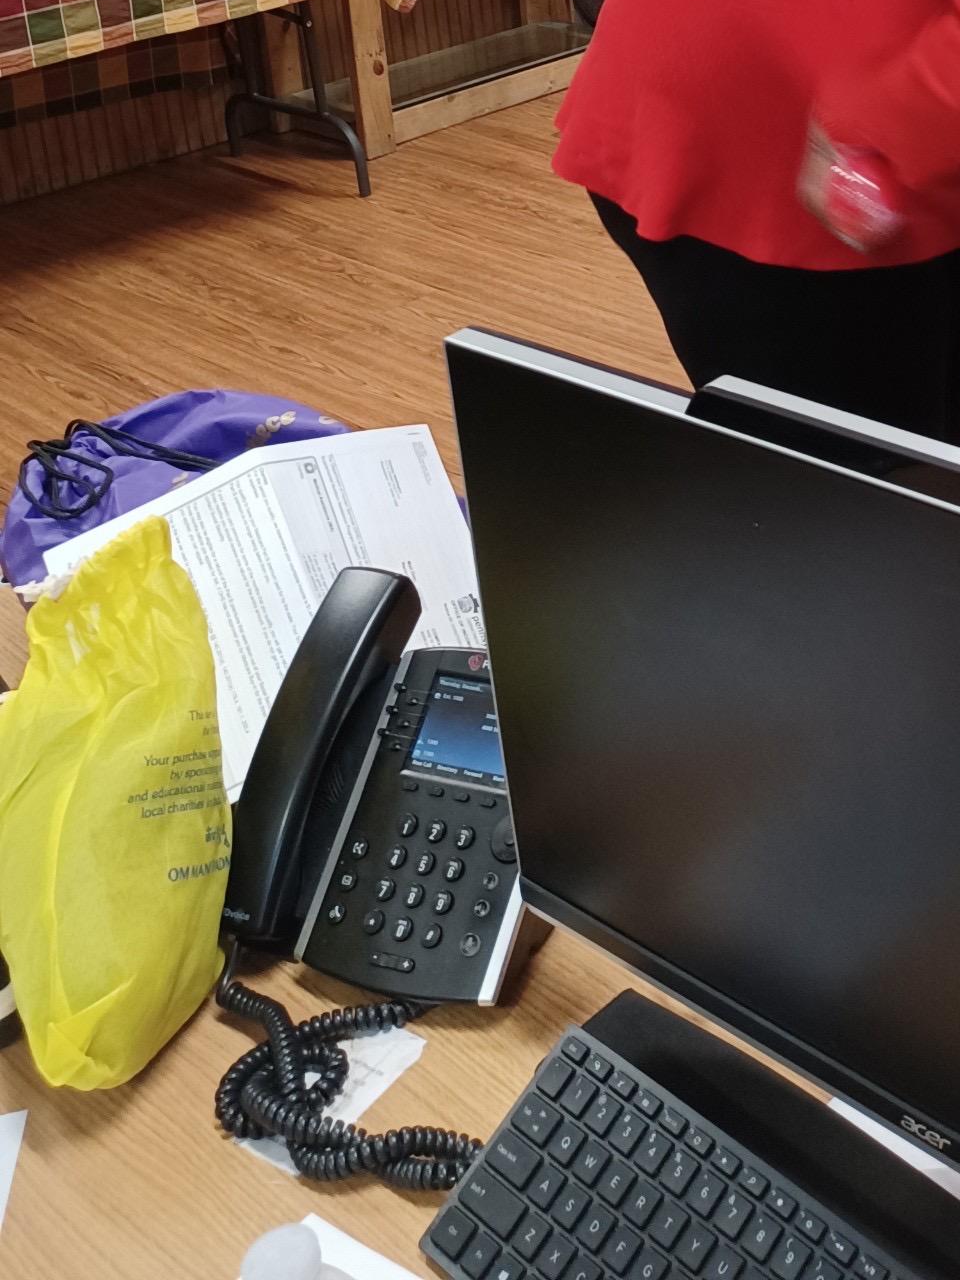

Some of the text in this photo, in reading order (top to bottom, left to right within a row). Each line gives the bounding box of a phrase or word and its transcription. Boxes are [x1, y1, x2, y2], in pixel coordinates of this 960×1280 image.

[144, 755, 170, 767] Your
[128, 789, 149, 804] and
[152, 782, 206, 800] educational
[141, 803, 166, 819] local
[402, 822, 409, 835] 1
[428, 828, 437, 841] 2
[457, 834, 466, 847] 3
[390, 854, 399, 866] 4
[418, 859, 428, 872] 5
[446, 866, 456, 879] 6
[378, 885, 388, 898] 7
[407, 892, 416, 905] 8
[435, 899, 445, 911] 9
[597, 1108, 607, 1119] 2
[622, 1126, 632, 1137] 3
[900, 1113, 951, 1151] acer
[560, 1136, 571, 1150] Q
[648, 1147, 657, 1158] 4
[585, 1154, 597, 1169] W
[674, 1165, 683, 1178] 5
[539, 1179, 550, 1193] A
[610, 1175, 621, 1189] E
[701, 1186, 710, 1199] 6
[565, 1198, 576, 1212] S
[635, 1195, 647, 1210] R
[728, 1207, 738, 1219] 7
[589, 1220, 600, 1233] D
[664, 1217, 674, 1230] T
[524, 1228, 536, 1242] Z
[615, 1240, 627, 1254] F
[691, 1238, 701, 1252] Y
[550, 1250, 561, 1264] X
[785, 1251, 795, 1264] 9
[642, 1263, 653, 1278] G
[718, 1260, 729, 1275] U
